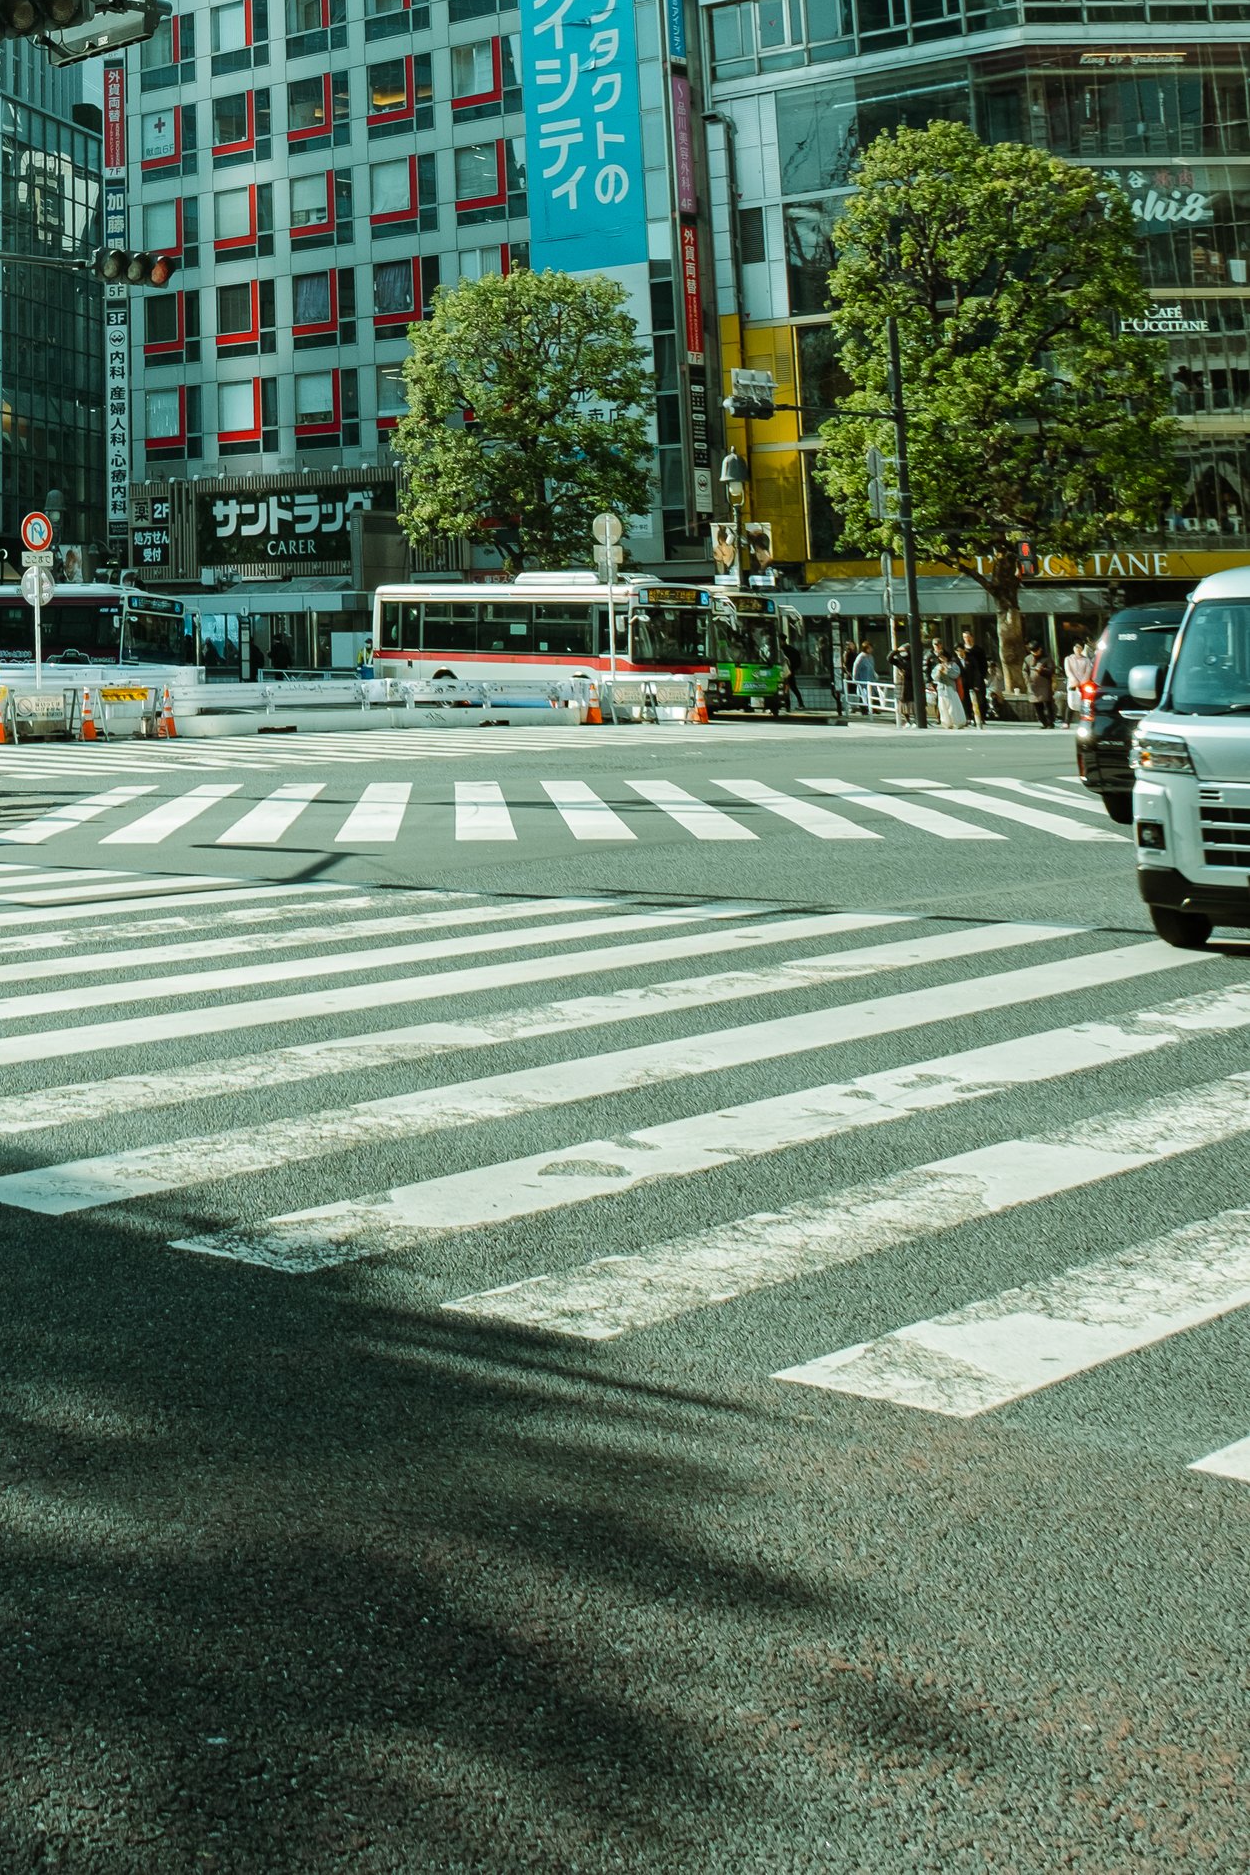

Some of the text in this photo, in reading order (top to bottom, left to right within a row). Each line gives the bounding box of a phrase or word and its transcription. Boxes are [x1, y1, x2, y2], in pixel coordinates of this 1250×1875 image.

[108, 70, 121, 124] 外貨両替
[677, 102, 691, 191] 品川美容外科
[109, 168, 122, 176] 7F
[680, 198, 693, 210] 4F
[109, 286, 125, 297] 5F
[109, 313, 125, 325] 3F
[1120, 317, 1211, 332] L'OCCITANE
[110, 350, 126, 380] 内科
[110, 386, 127, 515] 産婦人科・心療内科
[134, 501, 170, 522] 薬 2F
[134, 530, 170, 545] 処方せん
[143, 547, 162, 562] 受付
[267, 539, 317, 556] CARER
[24, 555, 51, 564] ここまで
